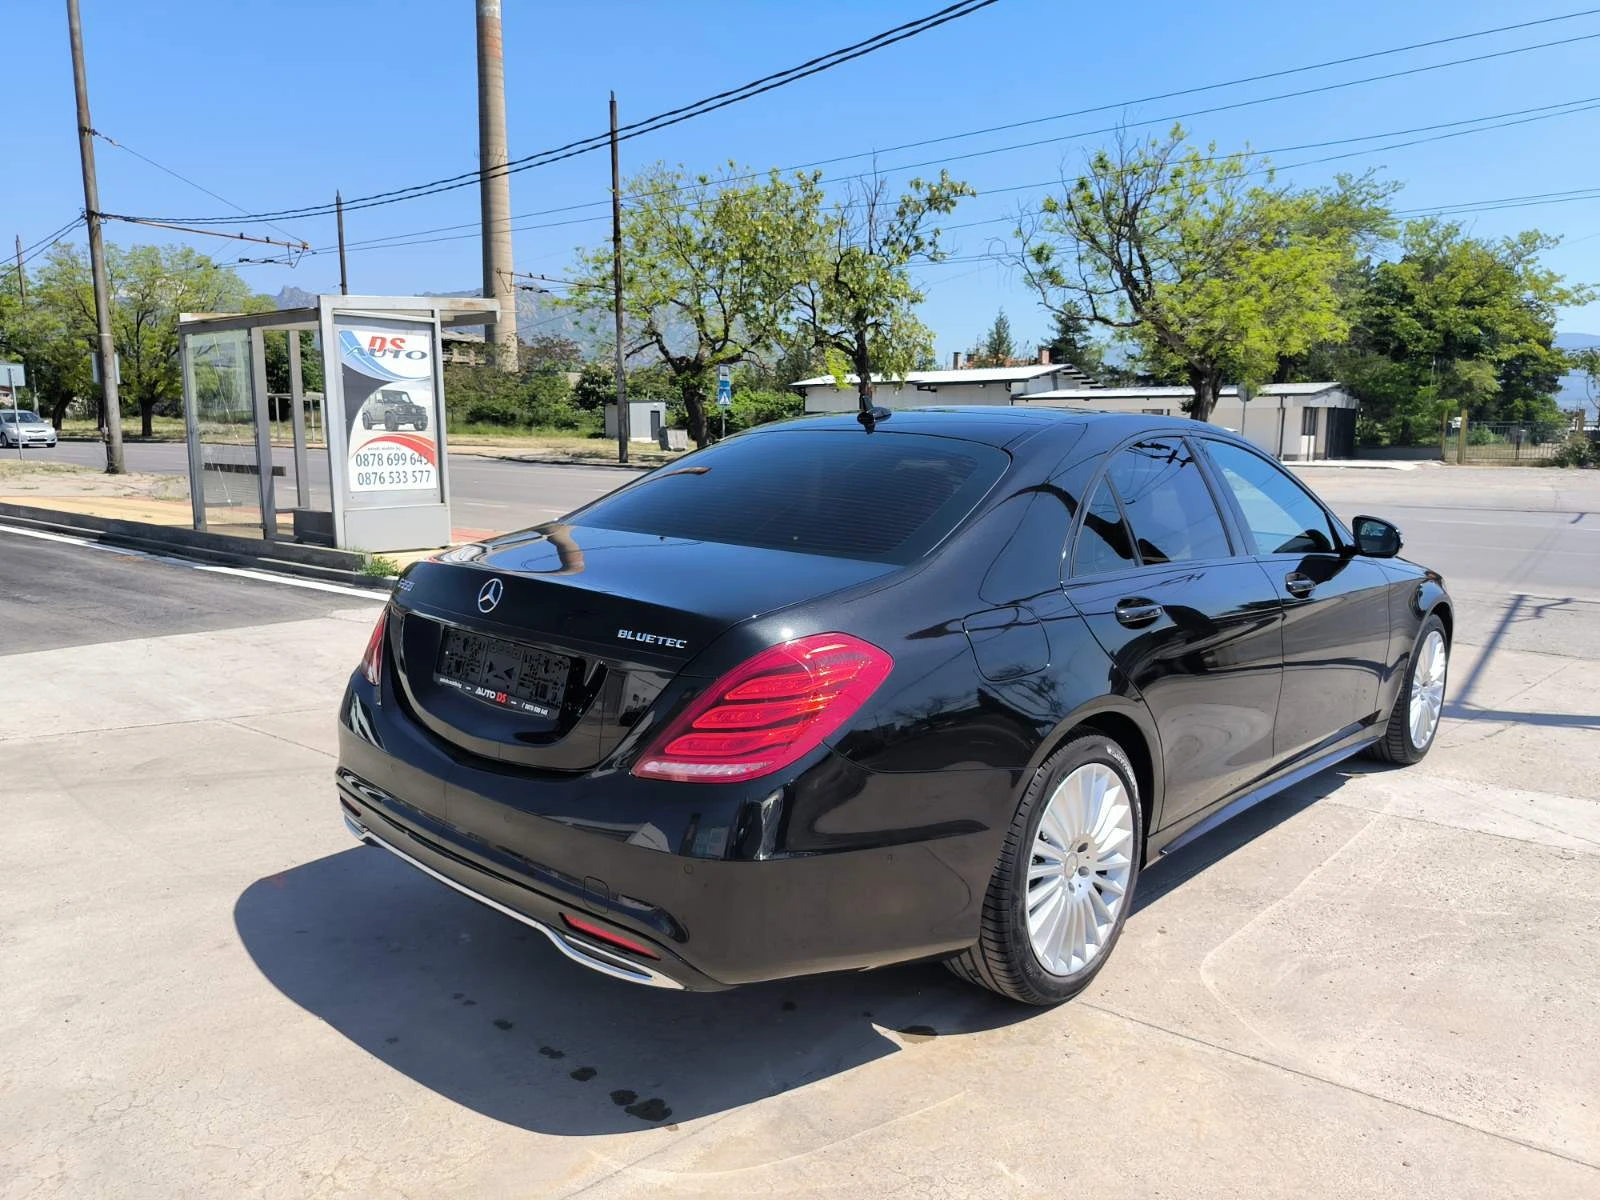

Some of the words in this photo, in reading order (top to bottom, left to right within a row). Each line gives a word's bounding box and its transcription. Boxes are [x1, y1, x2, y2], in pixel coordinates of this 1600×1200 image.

[369, 336, 406, 352] DS
[346, 345, 428, 360] AUTO
[355, 453, 384, 467] 0878
[386, 453, 407, 466] 699
[357, 471, 386, 486] 0876
[388, 470, 408, 484] 533
[411, 469, 431, 483] 577
[617, 629, 687, 649] BLUETEC
[475, 686, 496, 699] AUTO
[496, 691, 508, 703] DS
